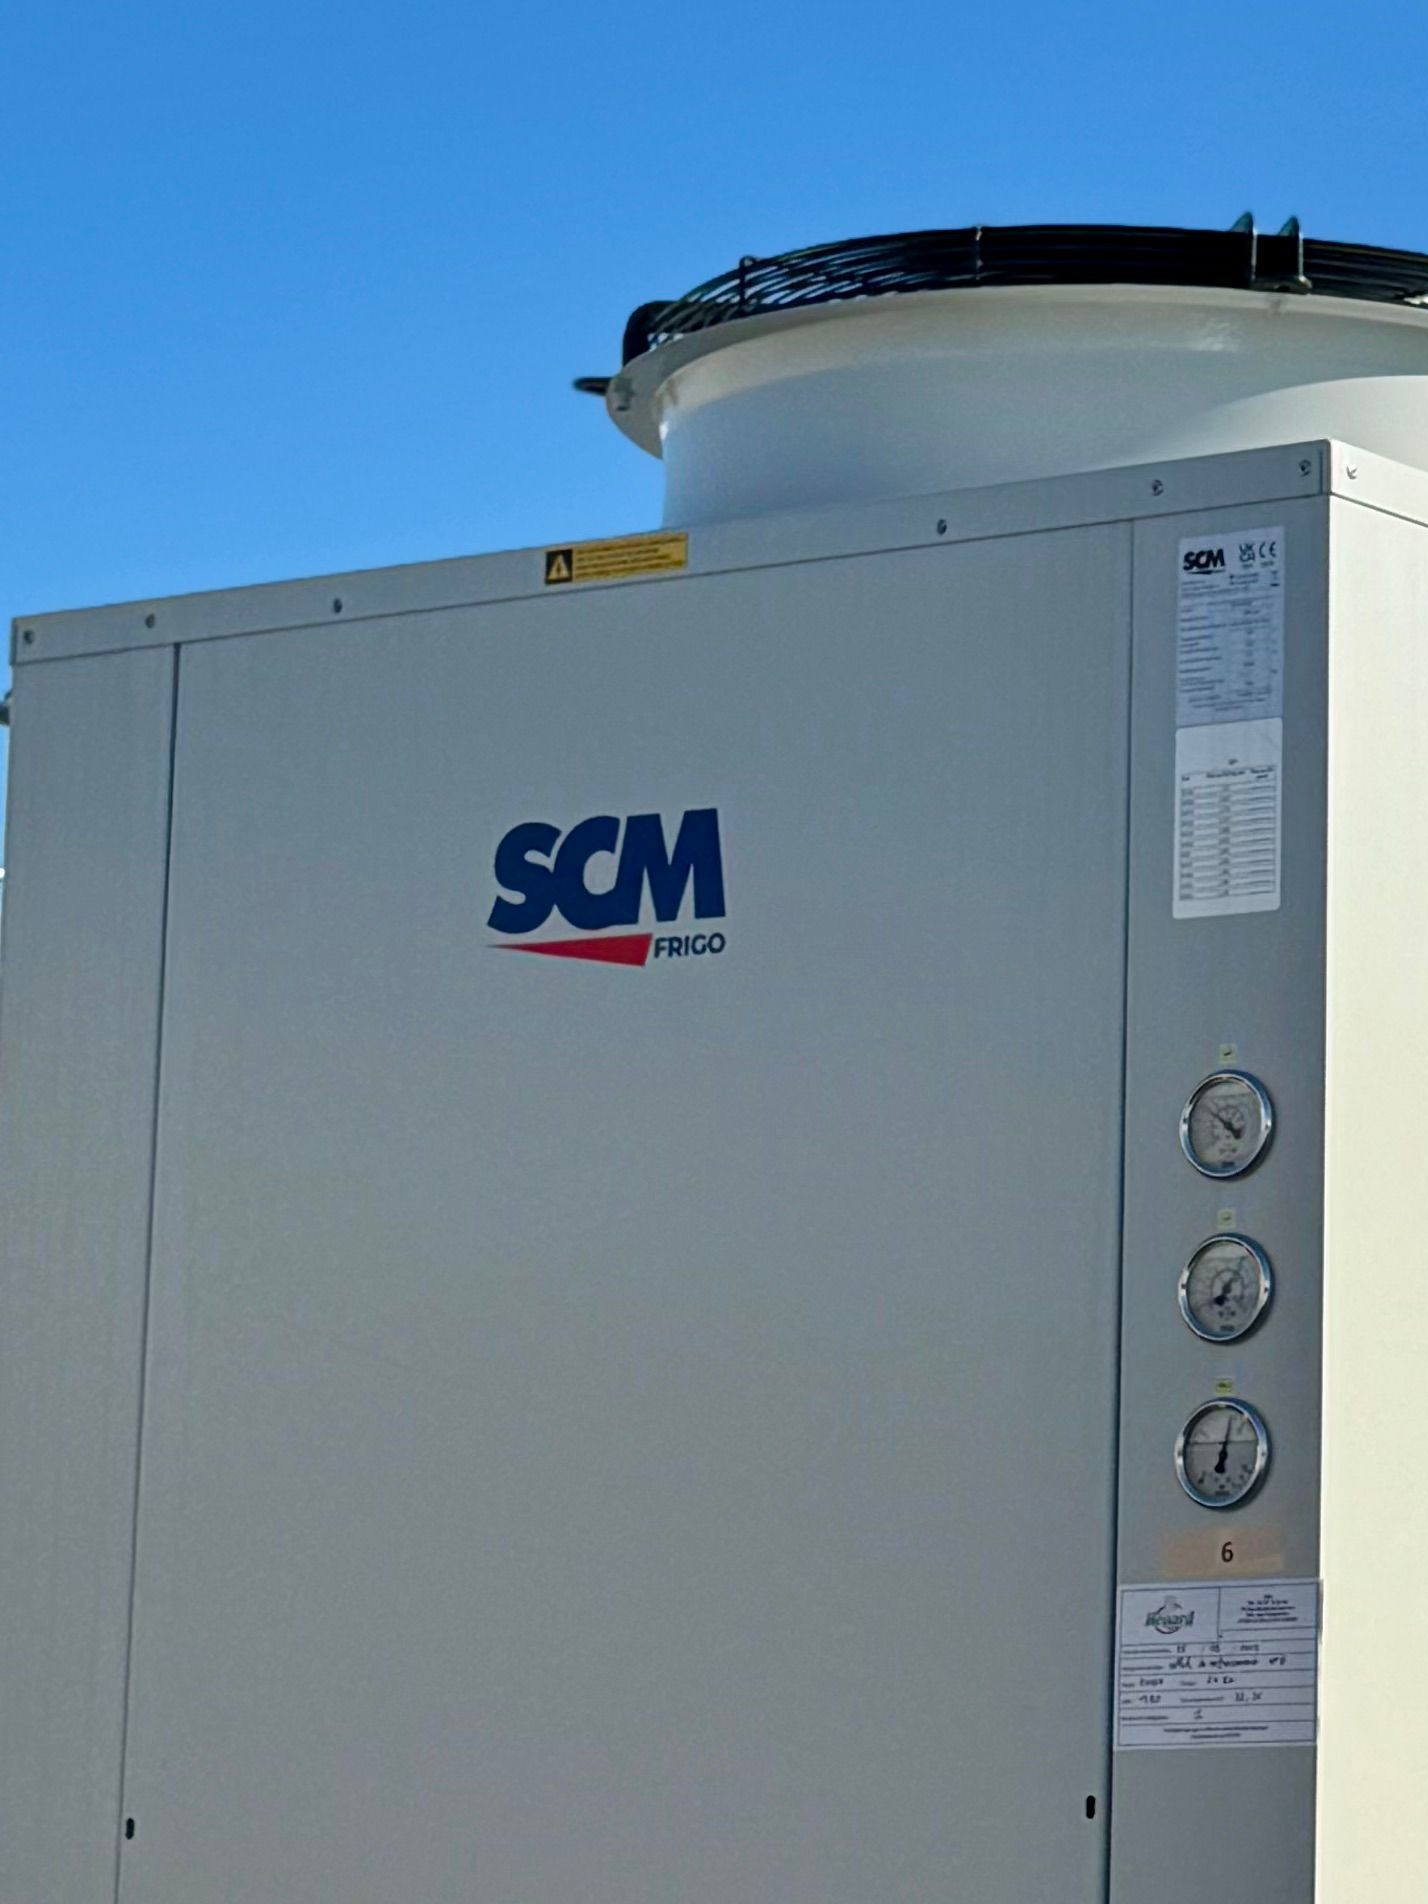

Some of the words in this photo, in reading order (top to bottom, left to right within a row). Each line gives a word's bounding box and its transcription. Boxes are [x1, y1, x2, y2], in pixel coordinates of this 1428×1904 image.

[1183, 549, 1226, 570] SCM
[487, 808, 726, 934] SCM
[653, 931, 727, 959] FRIGO
[1221, 1541, 1234, 1562] 6
